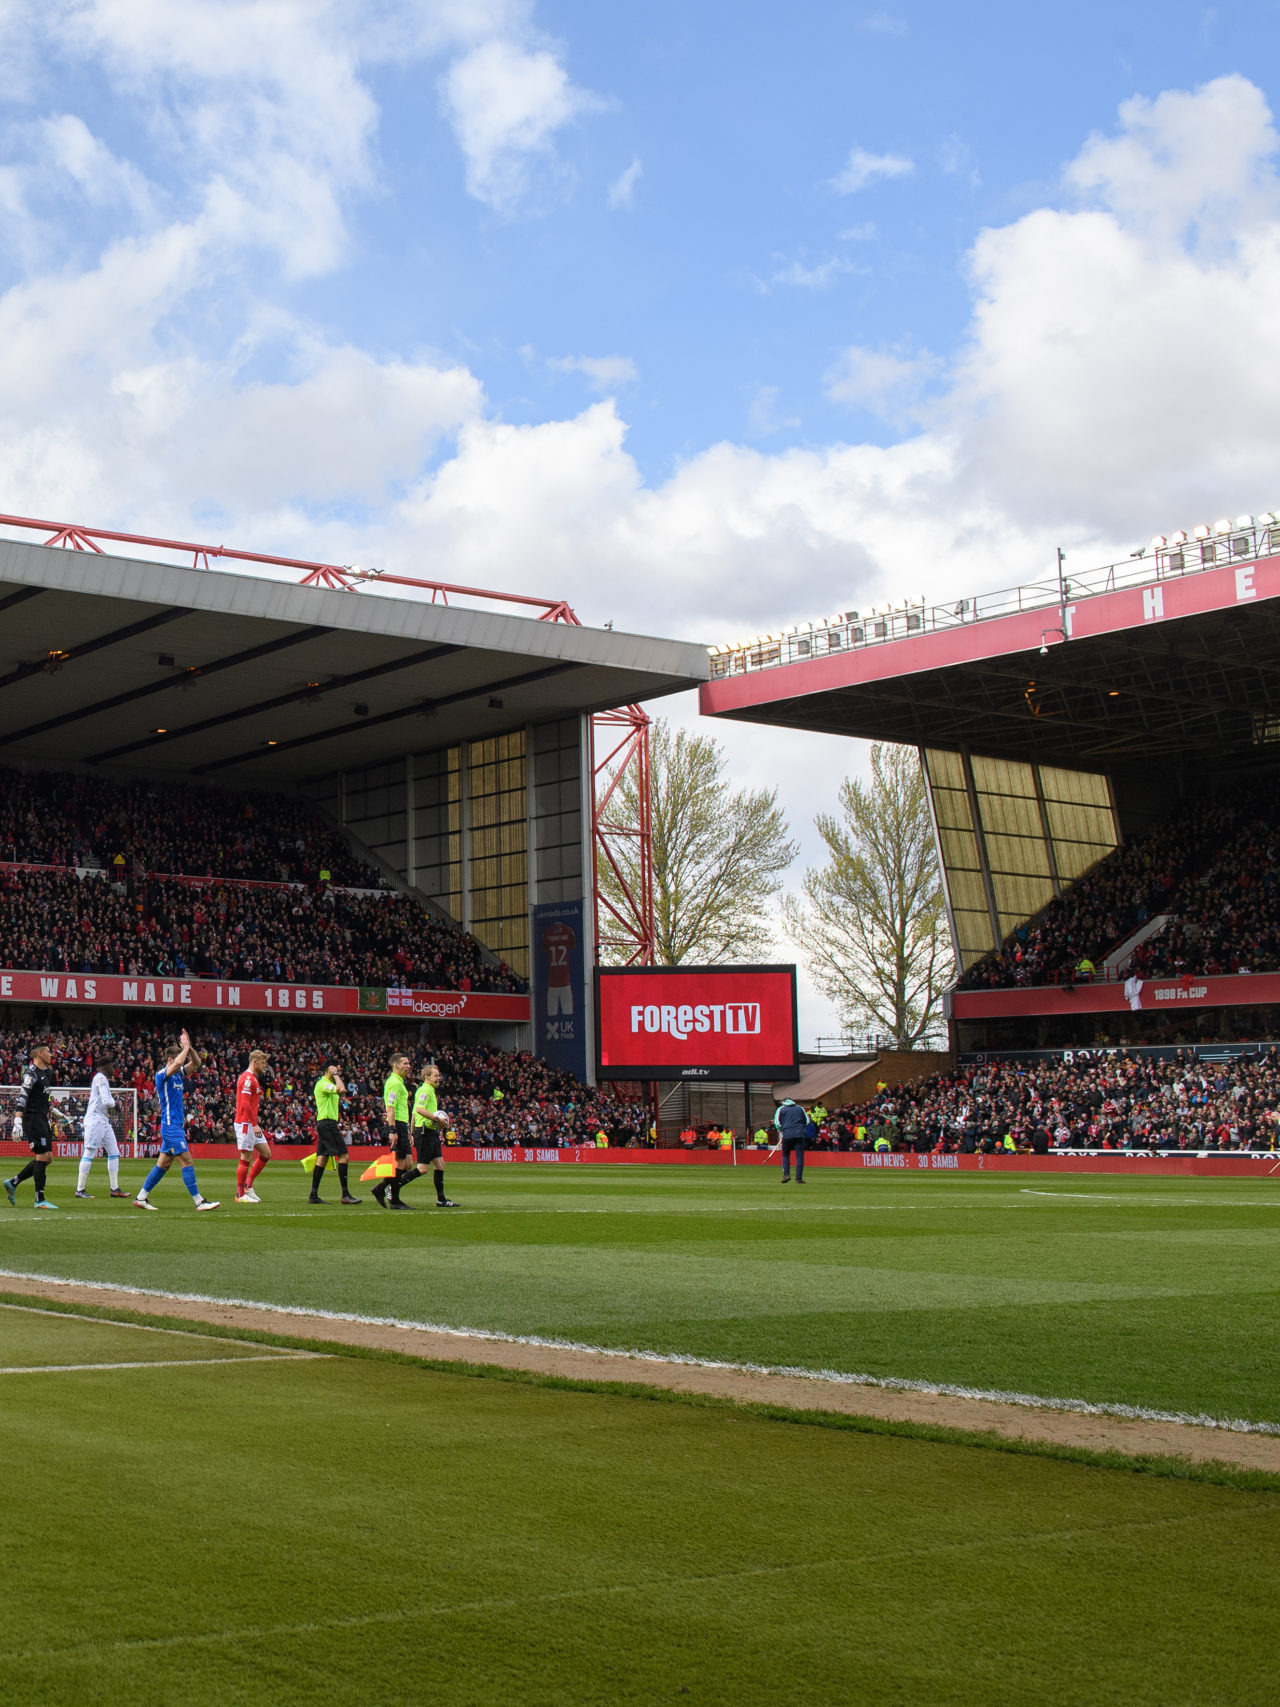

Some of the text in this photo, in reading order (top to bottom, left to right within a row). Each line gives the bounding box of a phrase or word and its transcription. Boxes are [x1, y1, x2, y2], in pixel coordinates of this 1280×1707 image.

[549, 945, 568, 967] 12
[40, 977, 97, 999] WAS
[122, 982, 192, 1004] MADE
[216, 986, 241, 1006] IN
[265, 988, 324, 1009] 1865
[1154, 988, 1176, 1000] 1898
[1189, 986, 1208, 999] CUP
[412, 999, 461, 1016] Ideagen
[728, 1004, 757, 1032] TV
[560, 1021, 574, 1032] UK
[56, 1143, 79, 1157] TEAM
[473, 1148, 492, 1161] TEAM
[525, 1149, 534, 1161] 30
[536, 1149, 560, 1162] SAMBA
[862, 1153, 883, 1166] TEAM
[918, 1154, 929, 1168] 30
[931, 1155, 959, 1169] SAMBA
